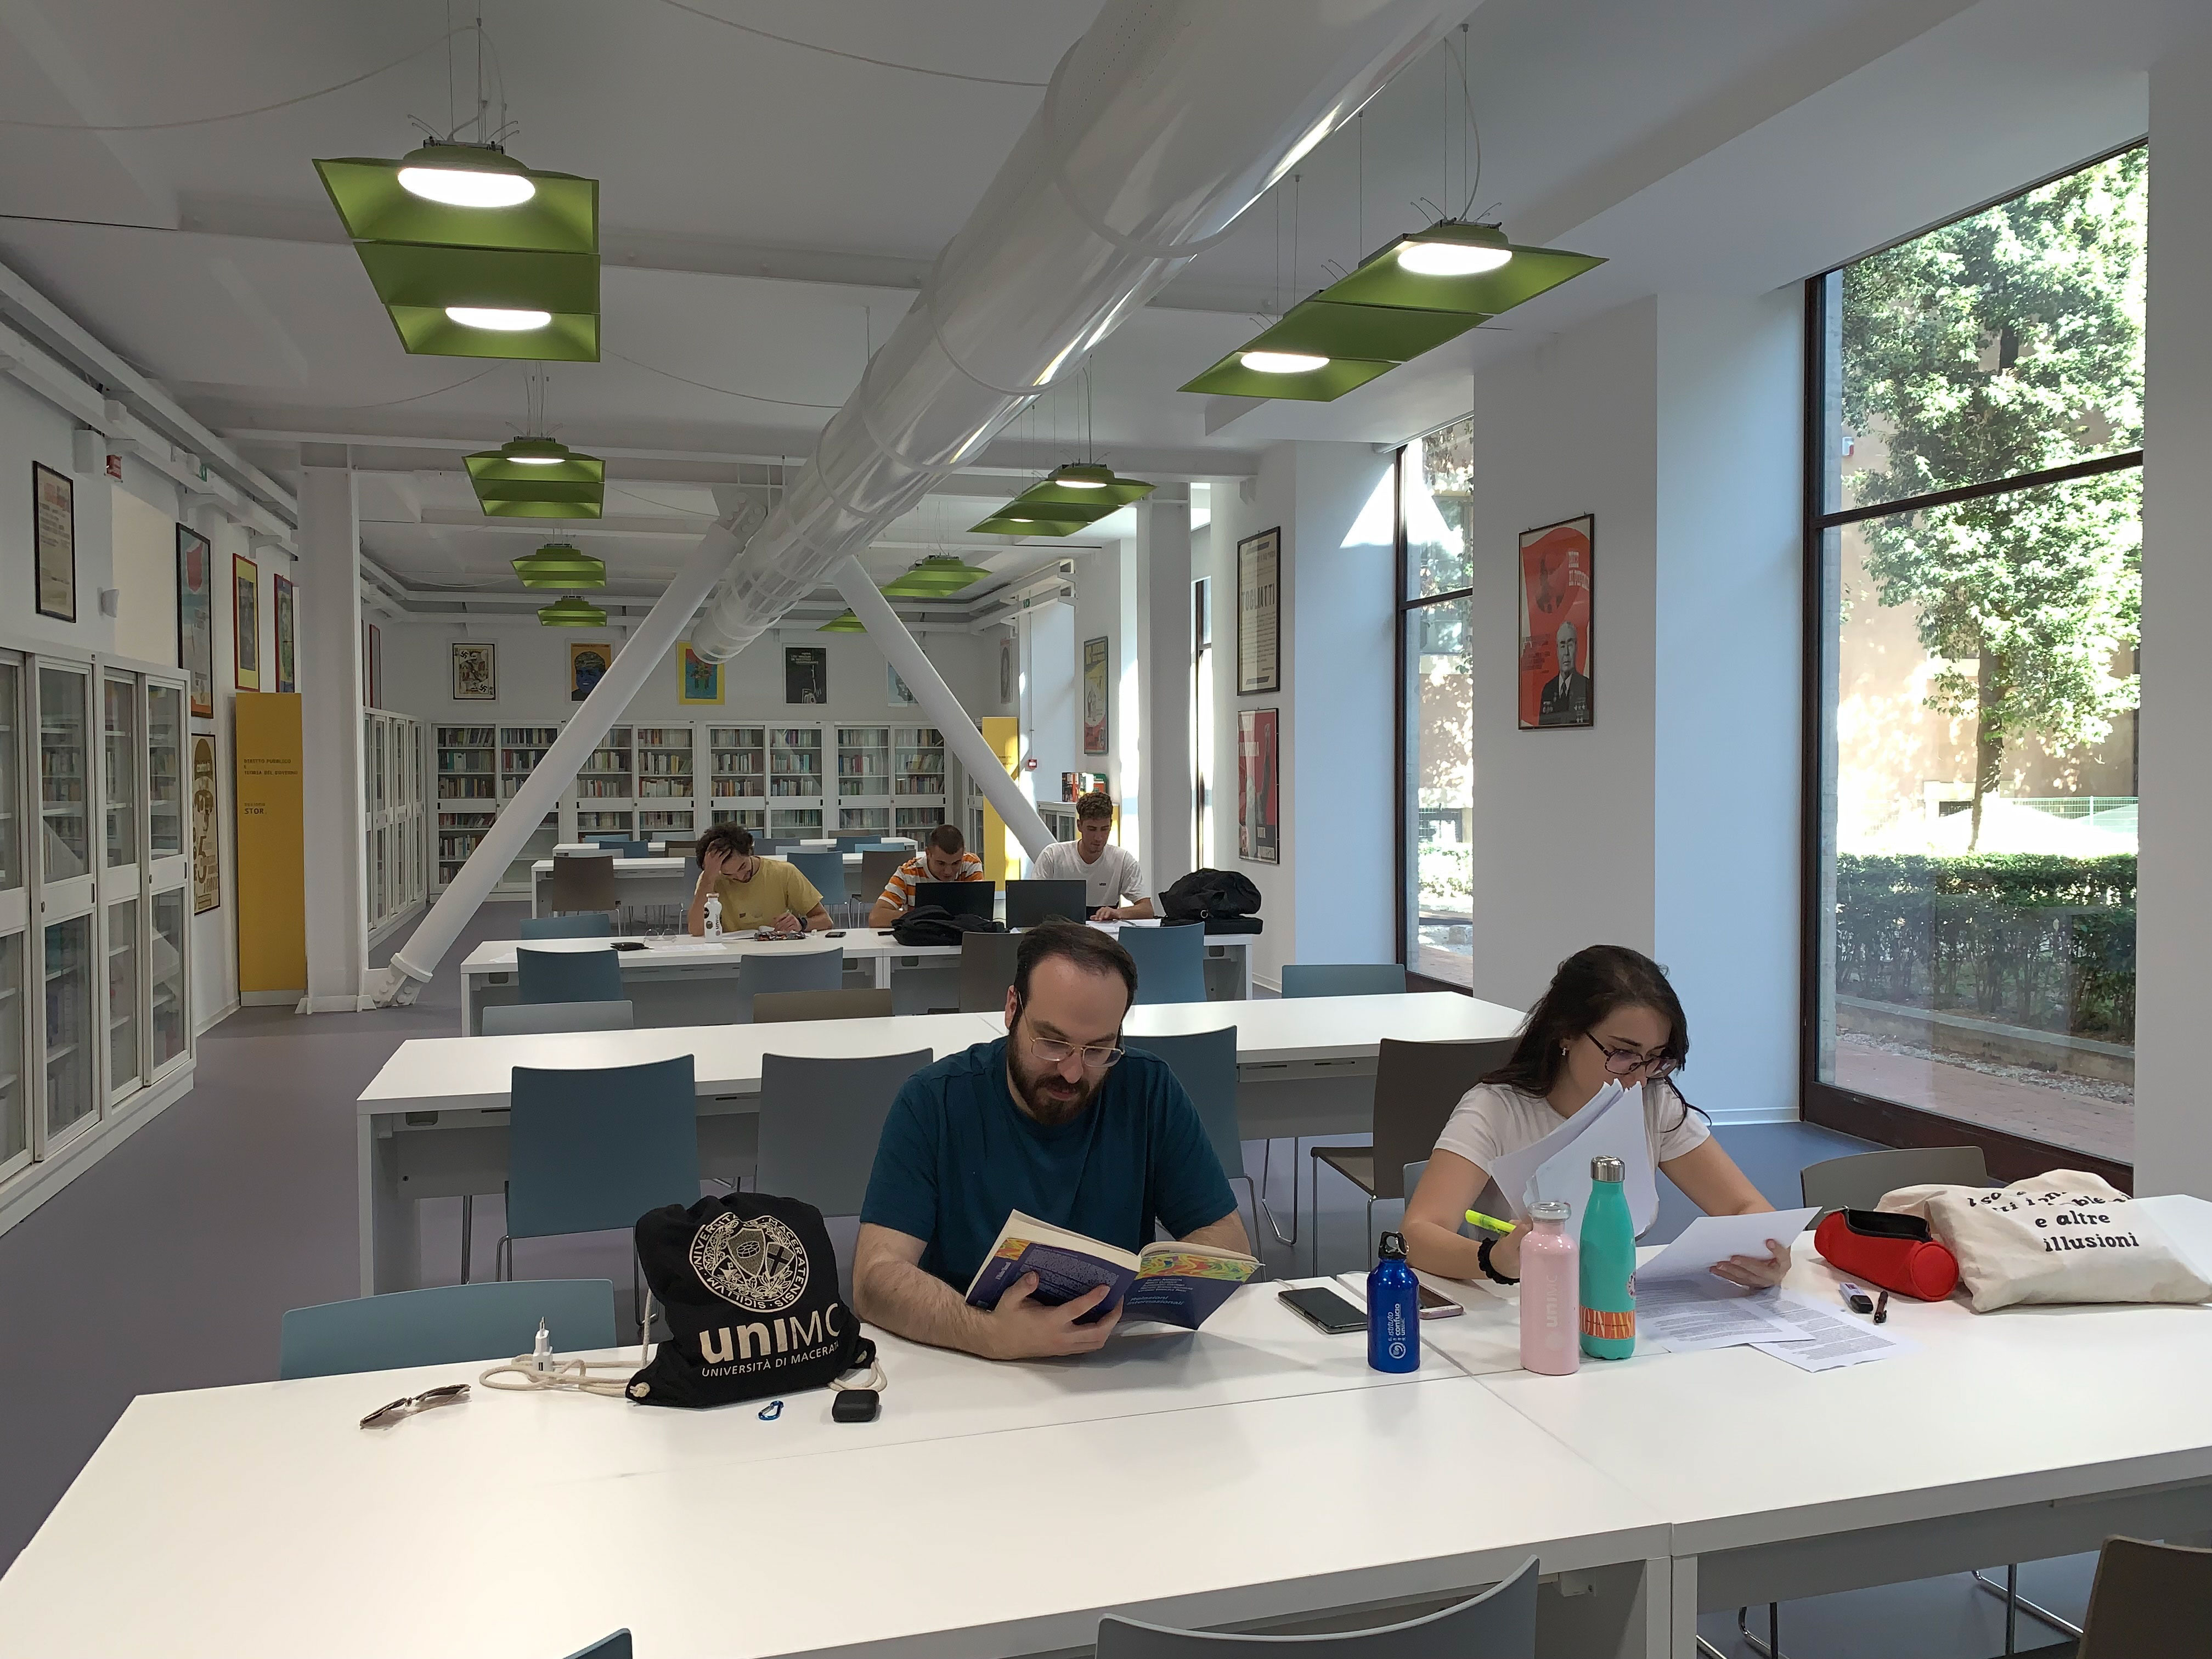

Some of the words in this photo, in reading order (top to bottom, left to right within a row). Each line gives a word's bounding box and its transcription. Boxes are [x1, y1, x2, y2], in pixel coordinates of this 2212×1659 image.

[2035, 1218, 2047, 1228] e
[2056, 1210, 2111, 1226] altre
[2043, 1232, 2139, 1252] illusioni
[769, 1217, 805, 1307] MACERATENSIS
[706, 1277, 766, 1309] SIGILLVM
[701, 1359, 771, 1377] UNIVERSITÀ
[775, 1358, 786, 1368] DI
